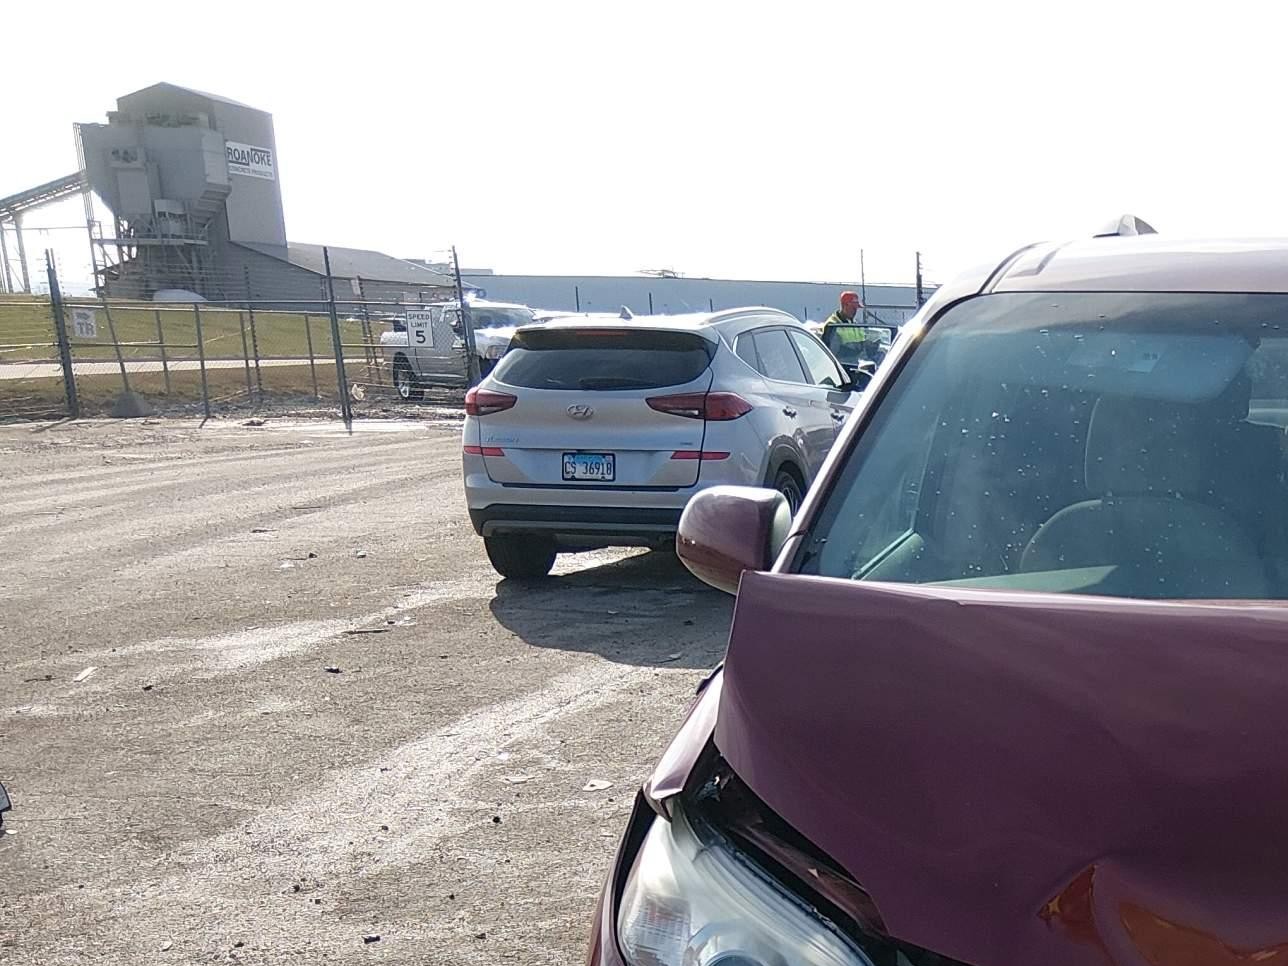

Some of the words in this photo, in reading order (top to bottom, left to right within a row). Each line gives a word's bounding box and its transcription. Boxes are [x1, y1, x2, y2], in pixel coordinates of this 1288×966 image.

[227, 147, 272, 167] ROANOKE
[415, 330, 426, 344] 5
[564, 461, 577, 475] CS
